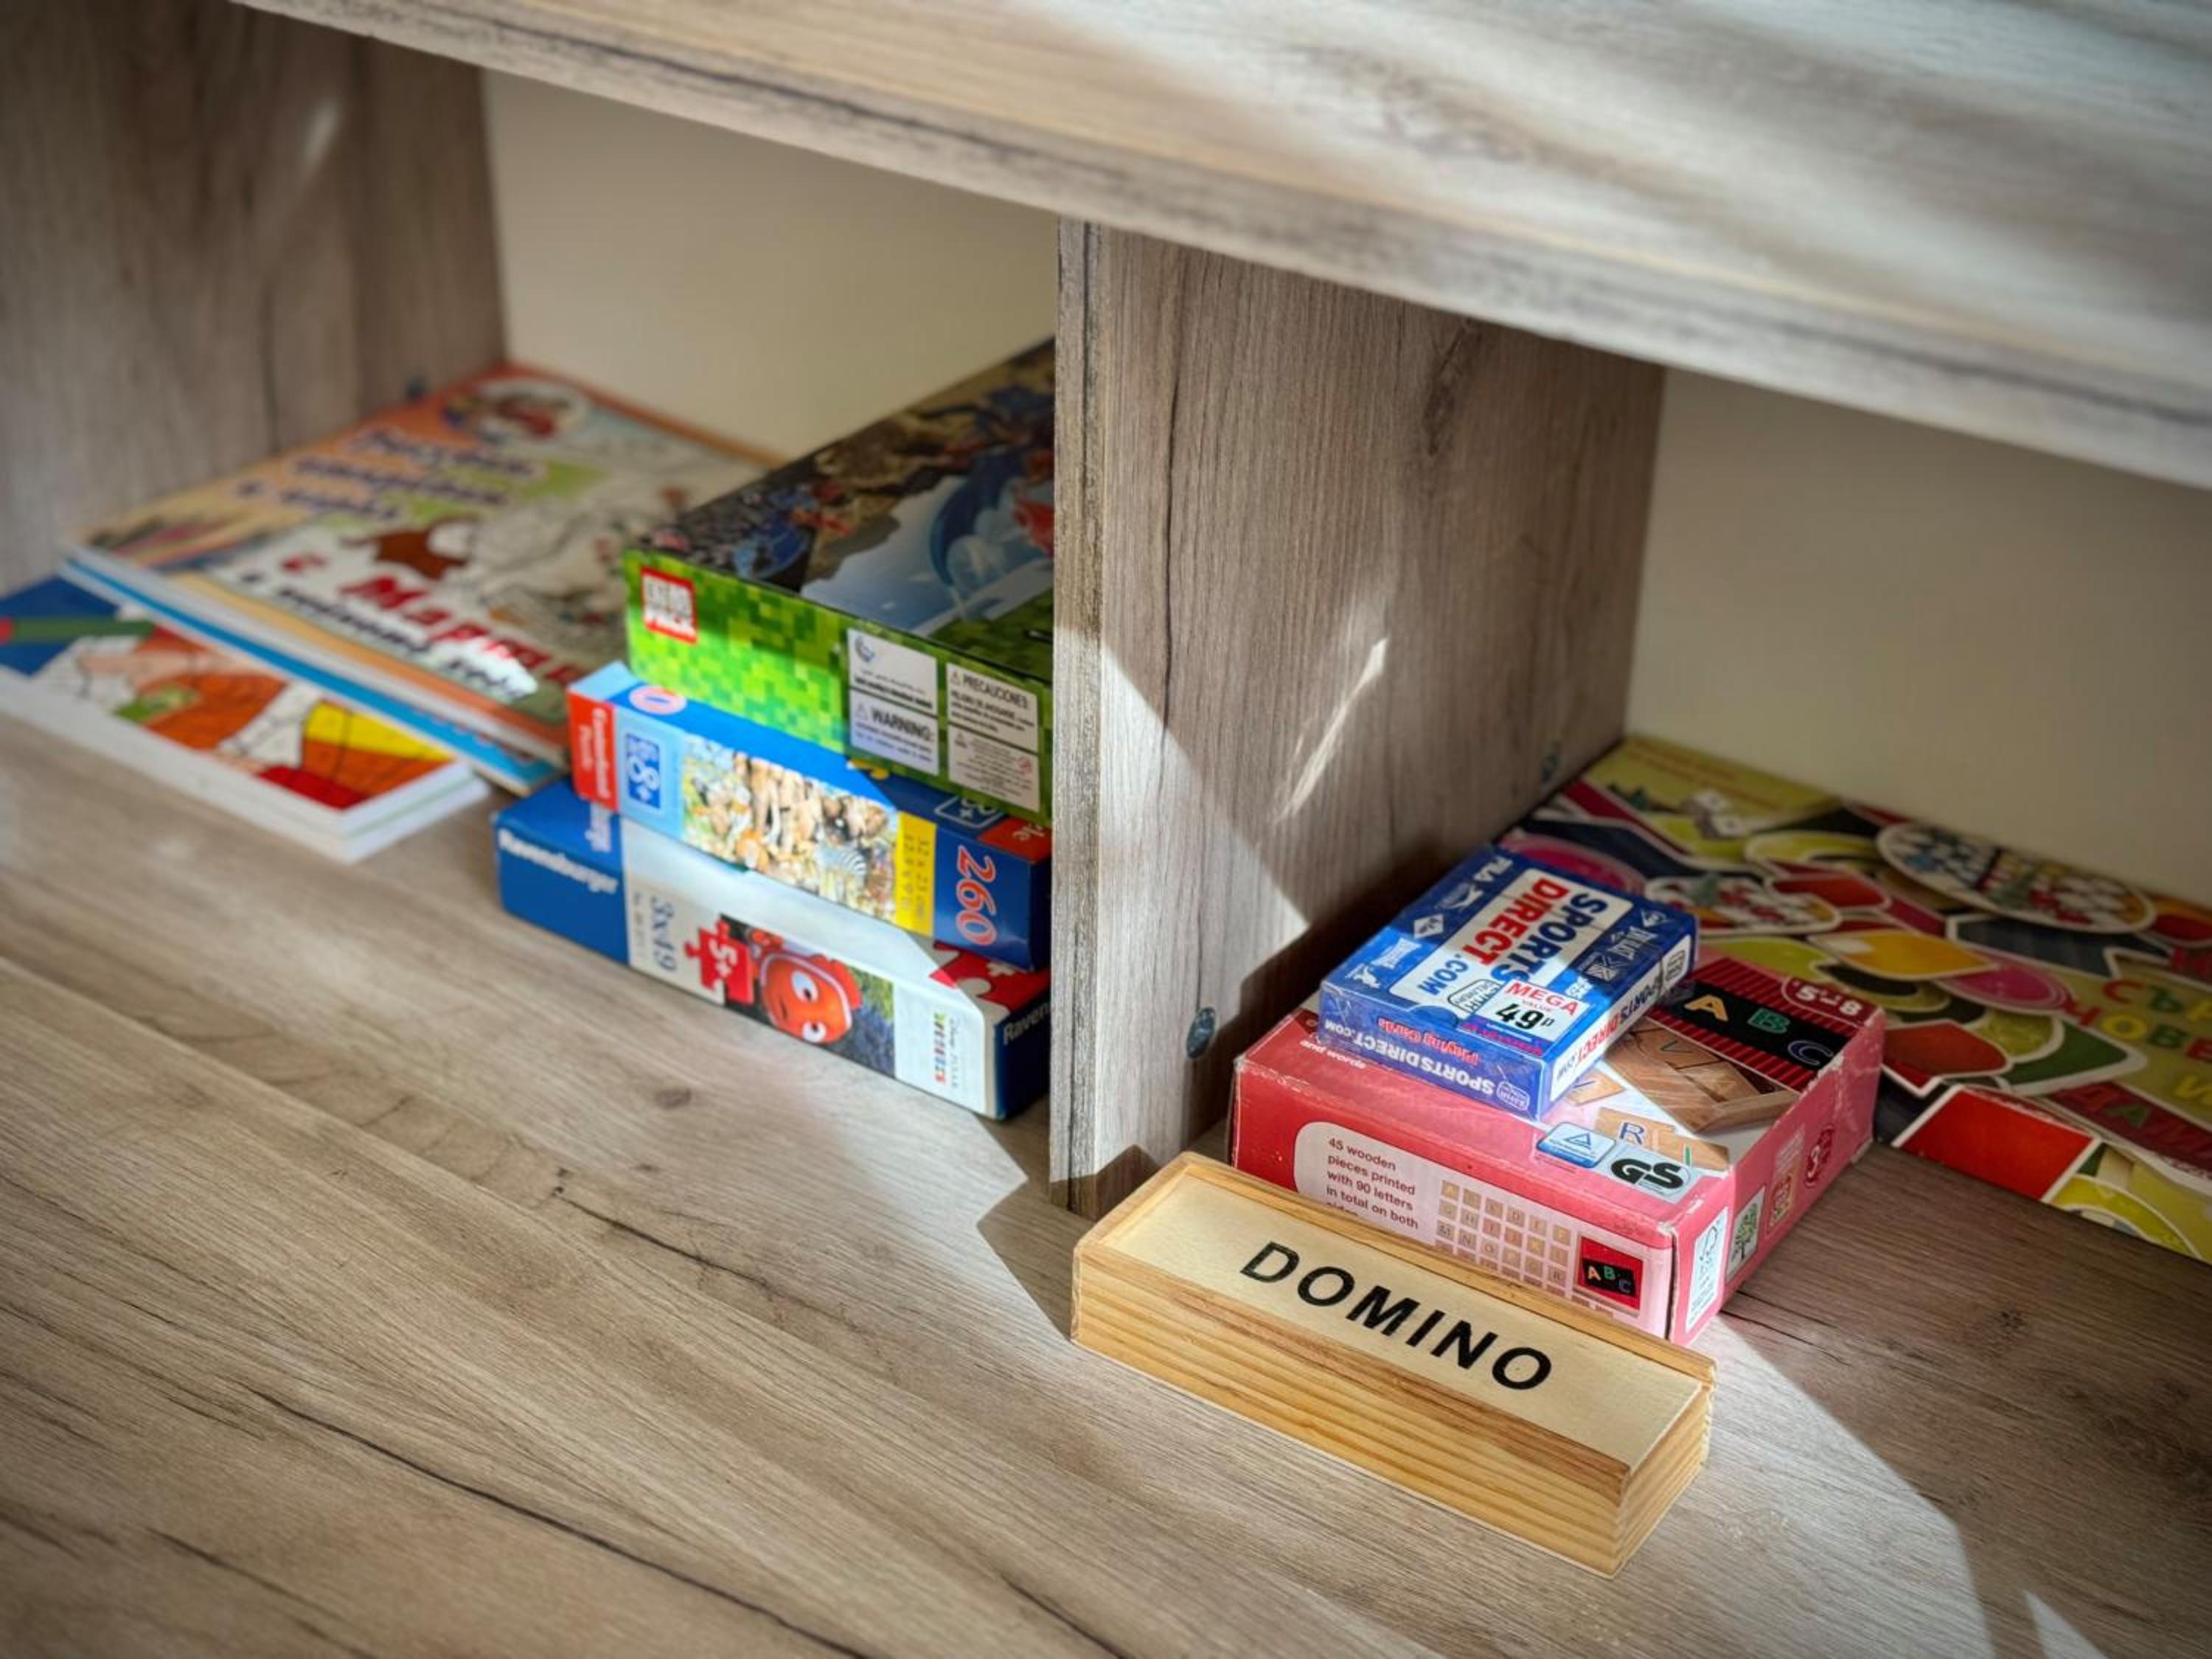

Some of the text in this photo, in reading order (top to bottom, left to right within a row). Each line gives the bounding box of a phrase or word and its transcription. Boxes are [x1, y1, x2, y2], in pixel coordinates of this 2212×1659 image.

[956, 844, 996, 945] 260
[1463, 878, 1570, 965] DIRECT
[1491, 893, 1608, 984] SPORTS
[708, 939, 737, 978] 5+
[1506, 982, 1579, 1015] MEGA
[1300, 1040, 1366, 1069] and words
[1619, 1121, 1645, 1144] R
[1329, 1138, 1396, 1171] 45 wooden
[1610, 1158, 1684, 1189] GS
[1327, 1171, 1353, 1187] with
[1357, 1180, 1371, 1194] 90
[1374, 1187, 1413, 1211] letters
[1328, 1155, 1416, 1196] pieces printed
[1326, 1186, 1338, 1197] in
[1341, 1191, 1368, 1209] total
[1371, 1205, 1387, 1217] on
[1390, 1209, 1419, 1230] both
[1587, 1265, 1632, 1293] ABC
[1240, 1240, 1552, 1391] DOMINO
